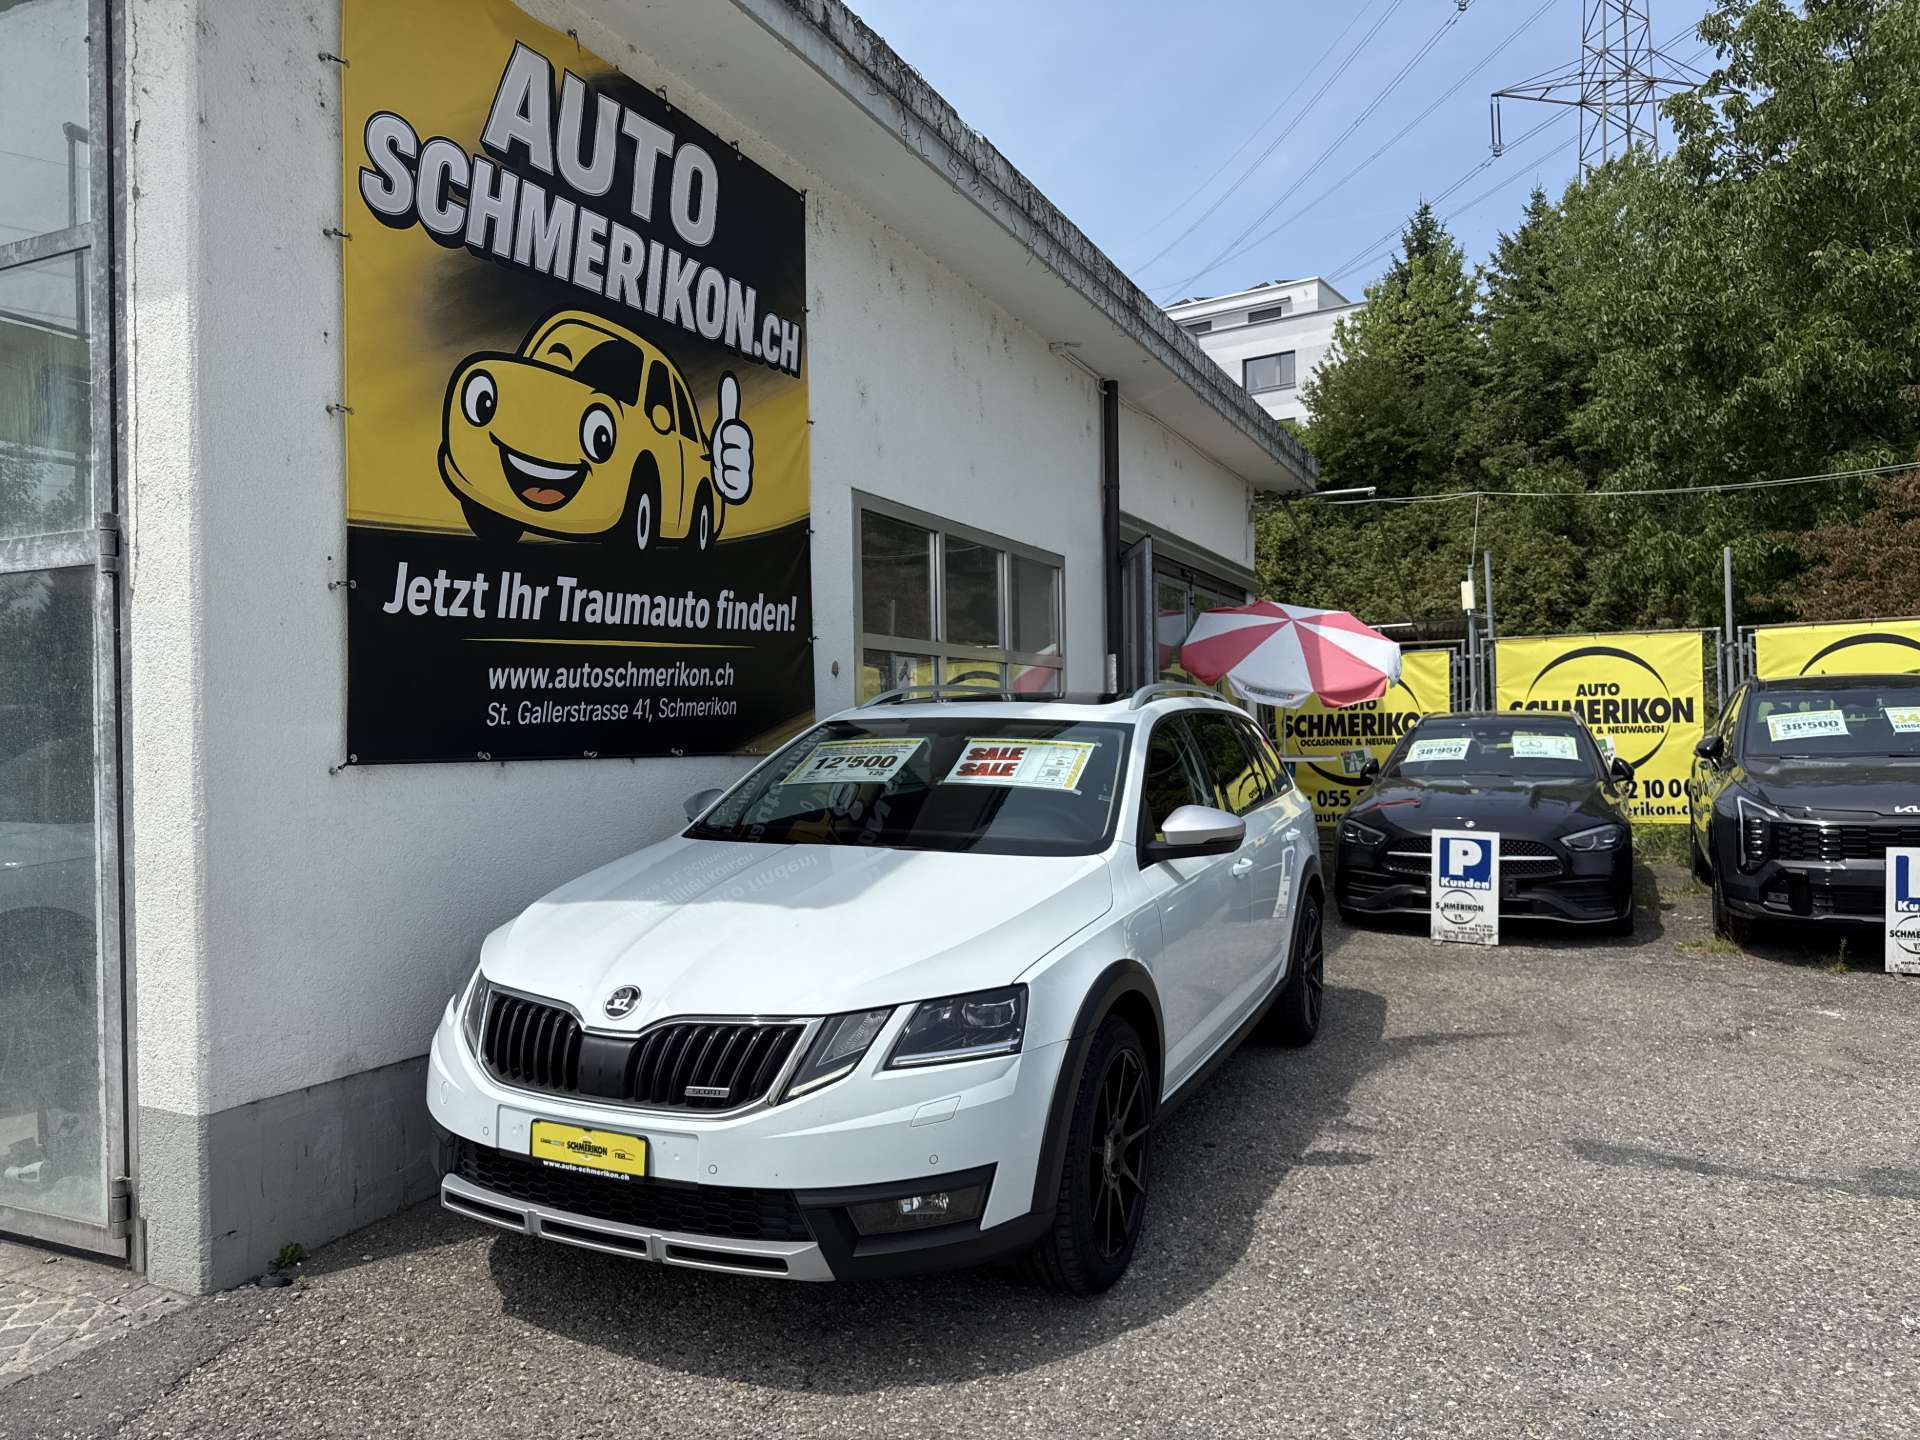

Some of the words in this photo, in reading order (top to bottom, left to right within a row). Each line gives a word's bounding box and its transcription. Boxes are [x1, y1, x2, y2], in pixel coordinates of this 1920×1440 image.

[481, 40, 719, 247] AUTO
[361, 112, 801, 375] SCHMERIKON.CH
[382, 561, 489, 619] Jetzt
[497, 571, 550, 621] Ihr
[556, 576, 710, 629] Traumauto
[716, 588, 797, 632] finden!
[488, 661, 734, 690] www.autoschmerikon.ch
[1575, 683, 1621, 697] AUTO
[486, 701, 511, 727] St.
[518, 698, 628, 725] Gallerstrasse
[632, 698, 653, 723] 41,
[658, 698, 737, 719] Schmerikon
[1282, 711, 1449, 738] SCHMERIKO
[1608, 725, 1664, 734] NEUWAGEN
[1300, 738, 1352, 747] OCCASIONEN
[814, 755, 898, 770] 12'500
[966, 747, 1027, 760] SALE
[956, 763, 1018, 776] SALE
[1317, 789, 1351, 807] 055
[1643, 780, 1664, 798] 10
[1449, 840, 1482, 876] P
[1441, 877, 1490, 889] Kunden
[1435, 902, 1484, 912] SHMERIKON
[567, 1141, 608, 1156] SCHMERIKON
[543, 1160, 630, 1181] www.auto-schmerikon.ch
